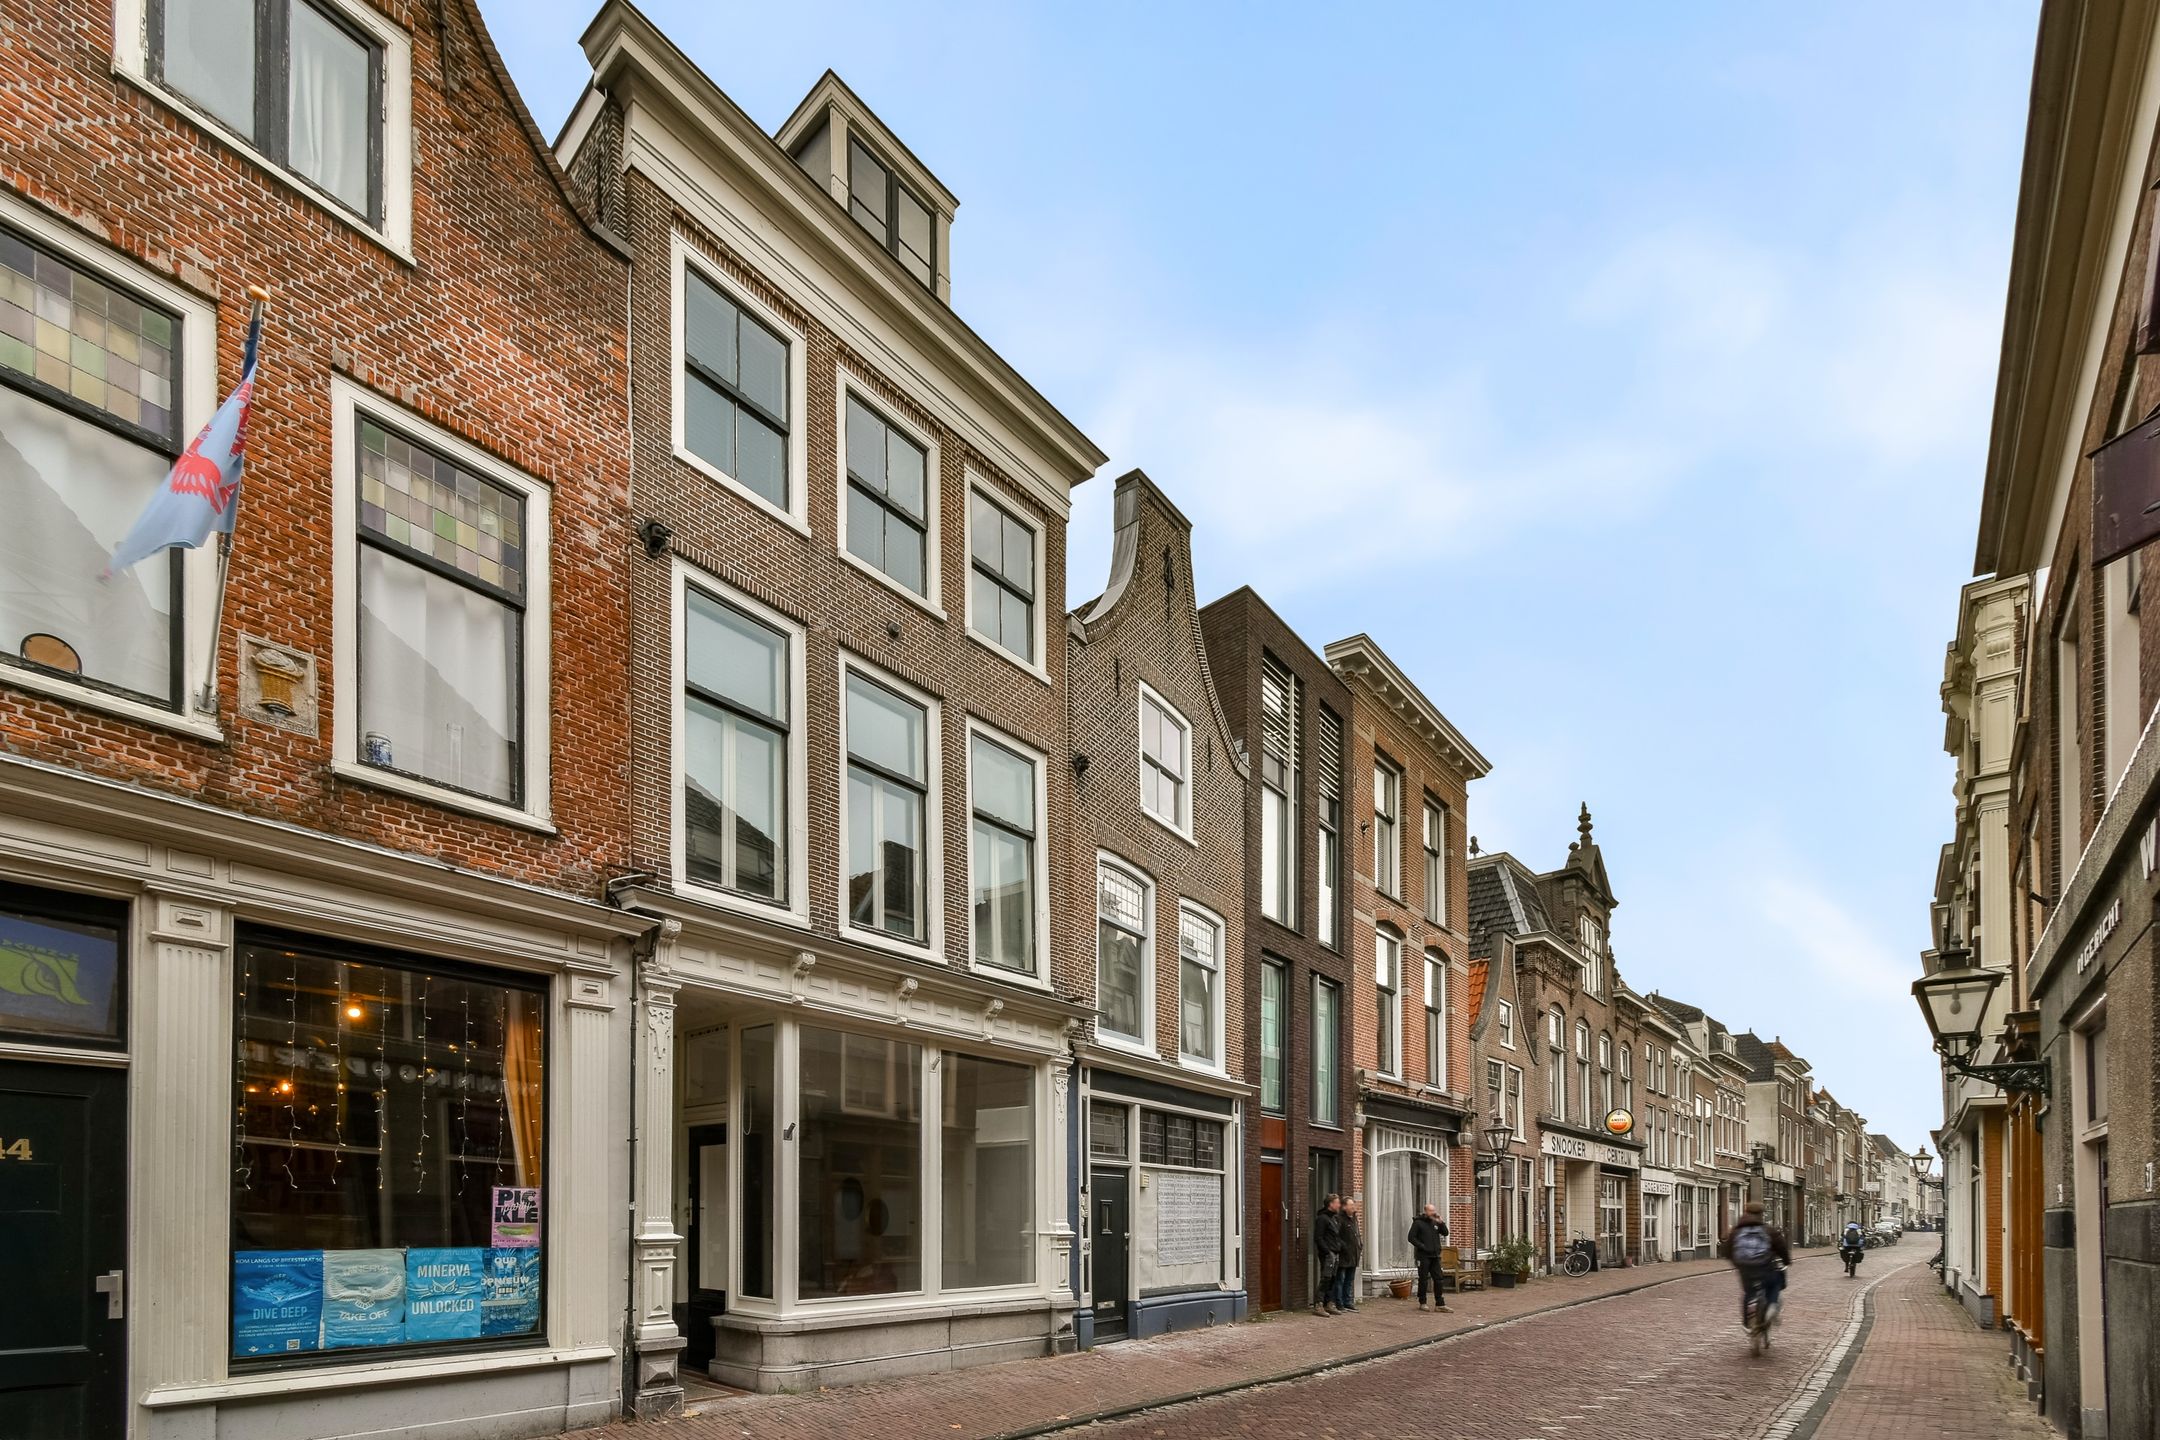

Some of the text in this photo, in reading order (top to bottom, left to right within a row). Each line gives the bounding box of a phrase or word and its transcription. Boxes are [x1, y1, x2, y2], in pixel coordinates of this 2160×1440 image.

[1551, 1136, 1586, 1158] SNOOKER
[1607, 1148, 1632, 1166] CENTRUM
[498, 1190, 537, 1206] PIC
[495, 1207, 539, 1223] KLE
[495, 1256, 517, 1267] OUD
[417, 1264, 471, 1278] MINERVA
[253, 1306, 308, 1320] DIVE DEEP
[339, 1308, 390, 1321] TAKE OFF
[412, 1299, 474, 1315] UNLOCKED
